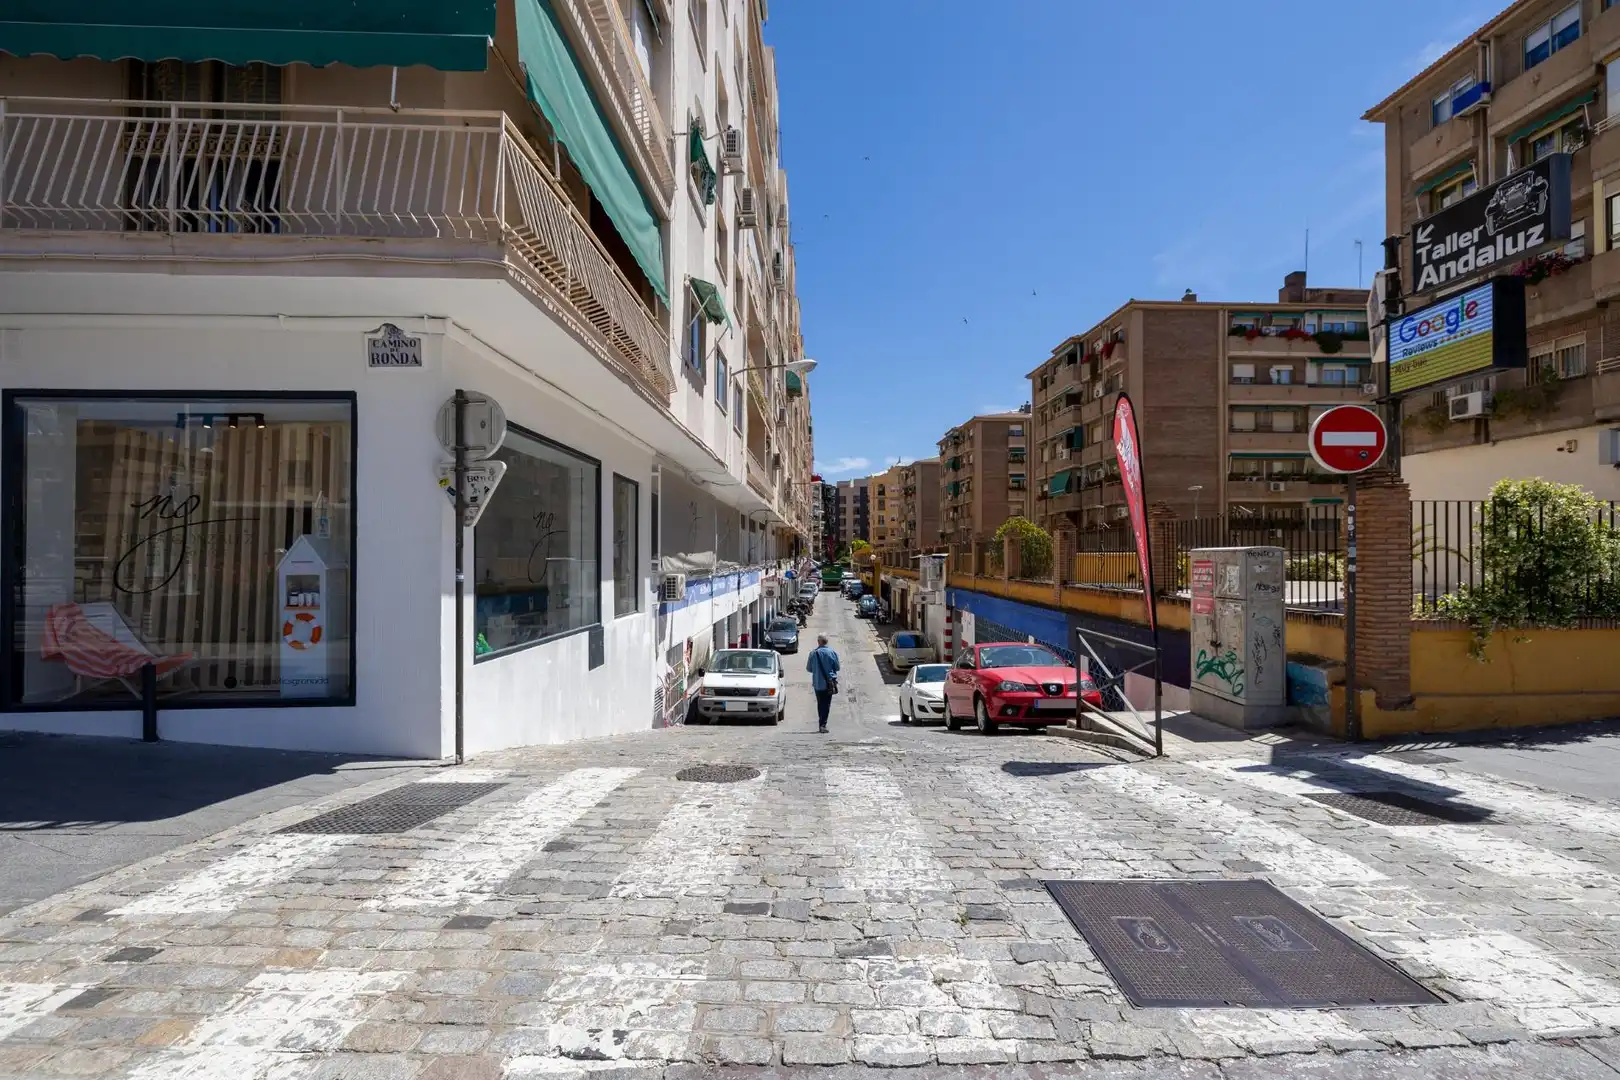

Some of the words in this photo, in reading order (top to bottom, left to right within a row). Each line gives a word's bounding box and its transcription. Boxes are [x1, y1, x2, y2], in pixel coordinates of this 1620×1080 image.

[1416, 224, 1484, 265] Taller
[1416, 223, 1545, 292] Andaluz
[1400, 296, 1479, 342] Google
[371, 352, 419, 364] RONDA
[373, 339, 416, 348] CAMINO
[1402, 339, 1438, 357] Reviews
